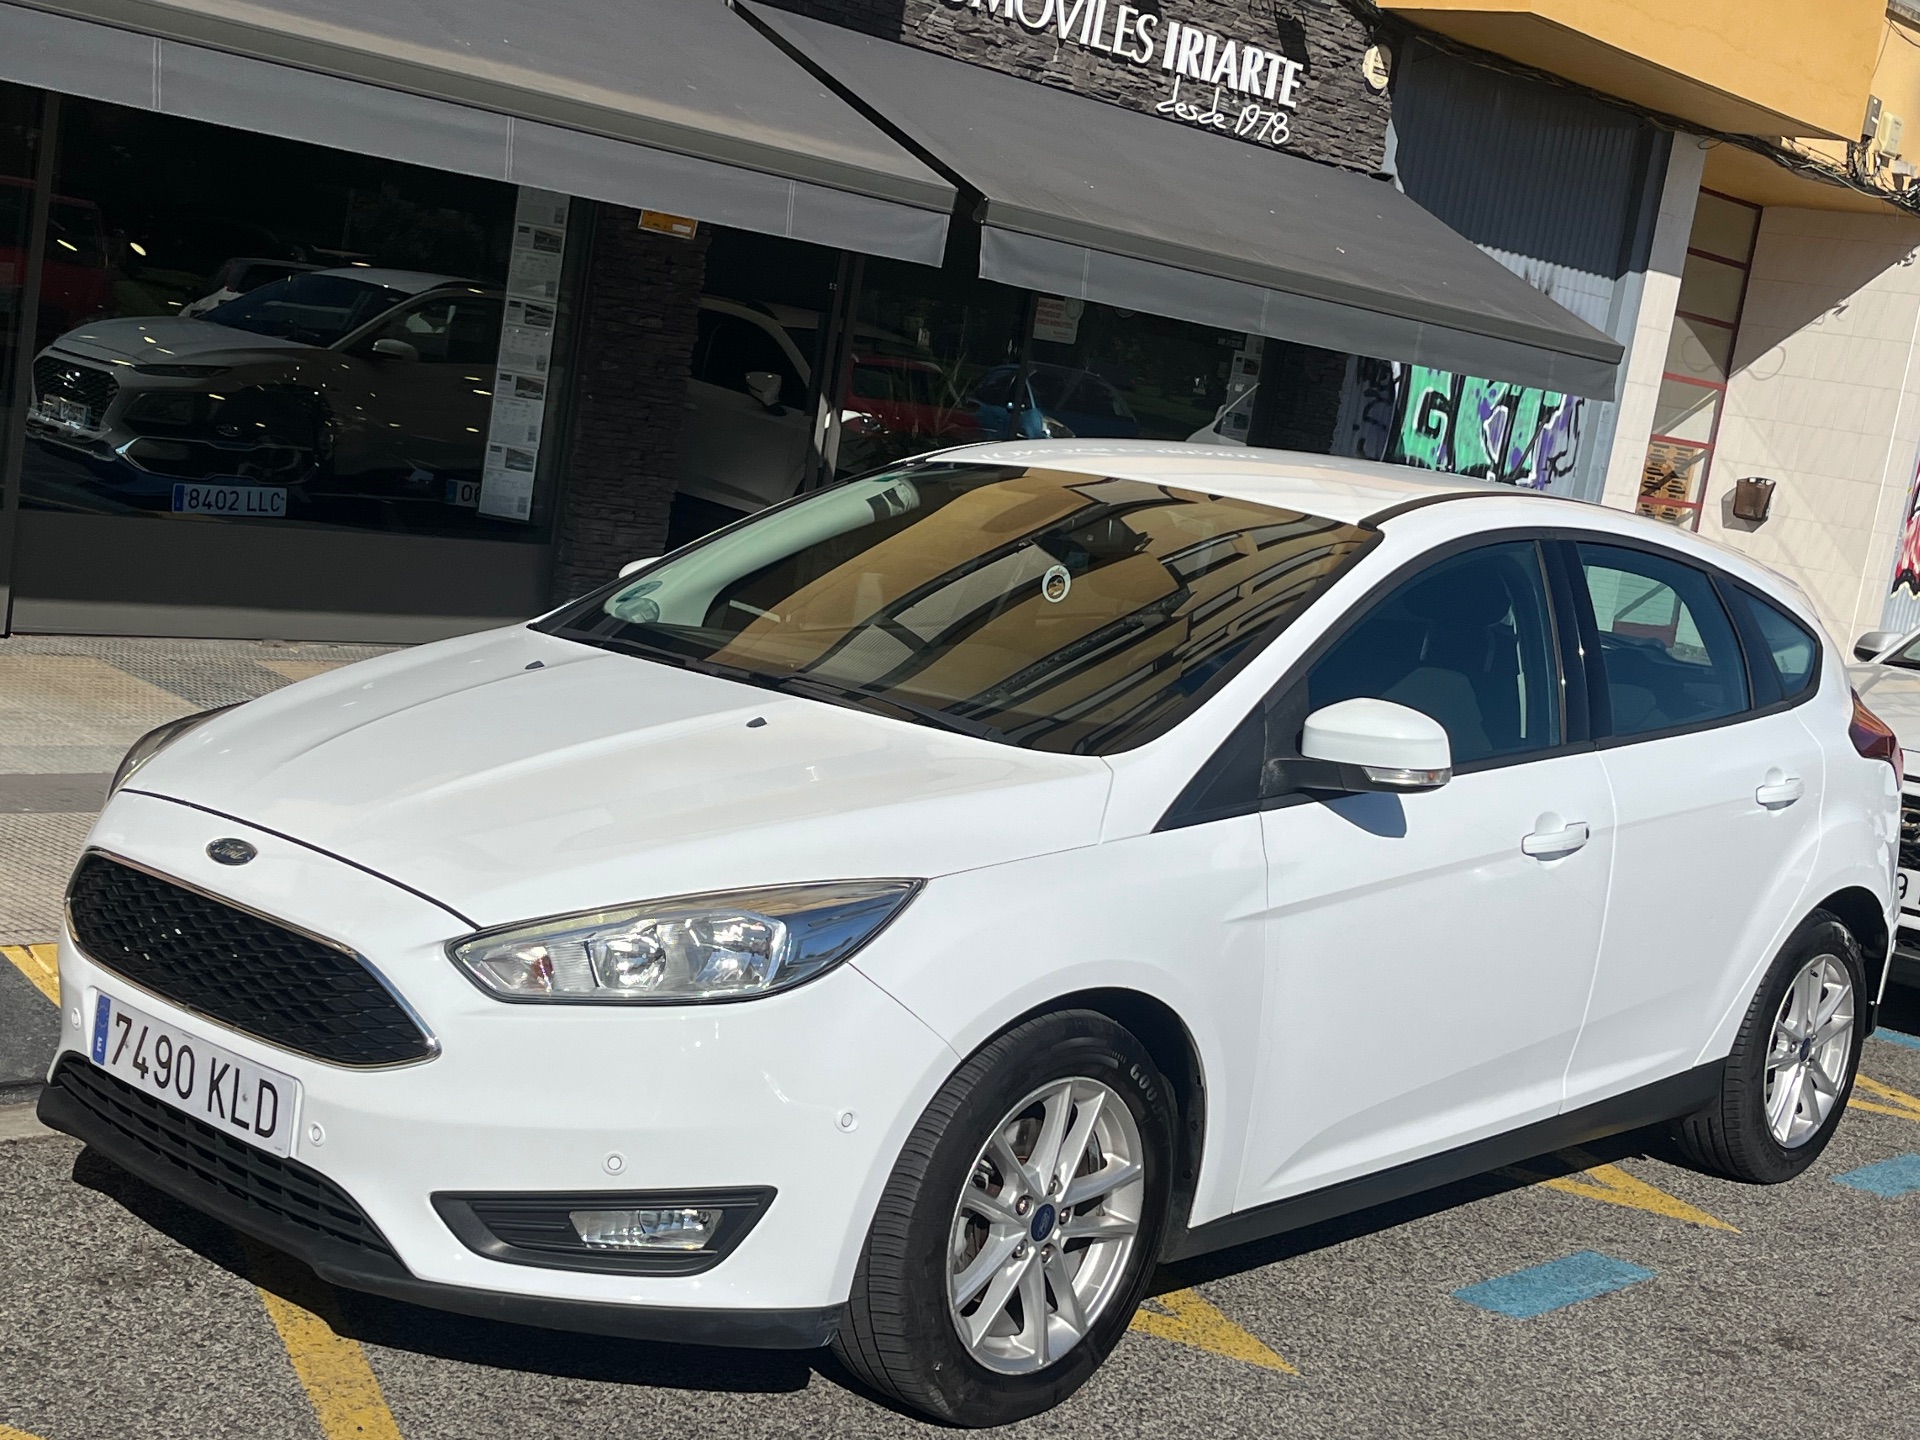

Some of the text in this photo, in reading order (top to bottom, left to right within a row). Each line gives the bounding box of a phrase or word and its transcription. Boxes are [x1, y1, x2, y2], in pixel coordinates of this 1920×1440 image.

[1162, 21, 1304, 109] IRIARTE
[1155, 75, 1290, 144] desde 1978
[188, 488, 281, 512] 8402 LLC
[111, 1011, 278, 1138] 7490 KLD
